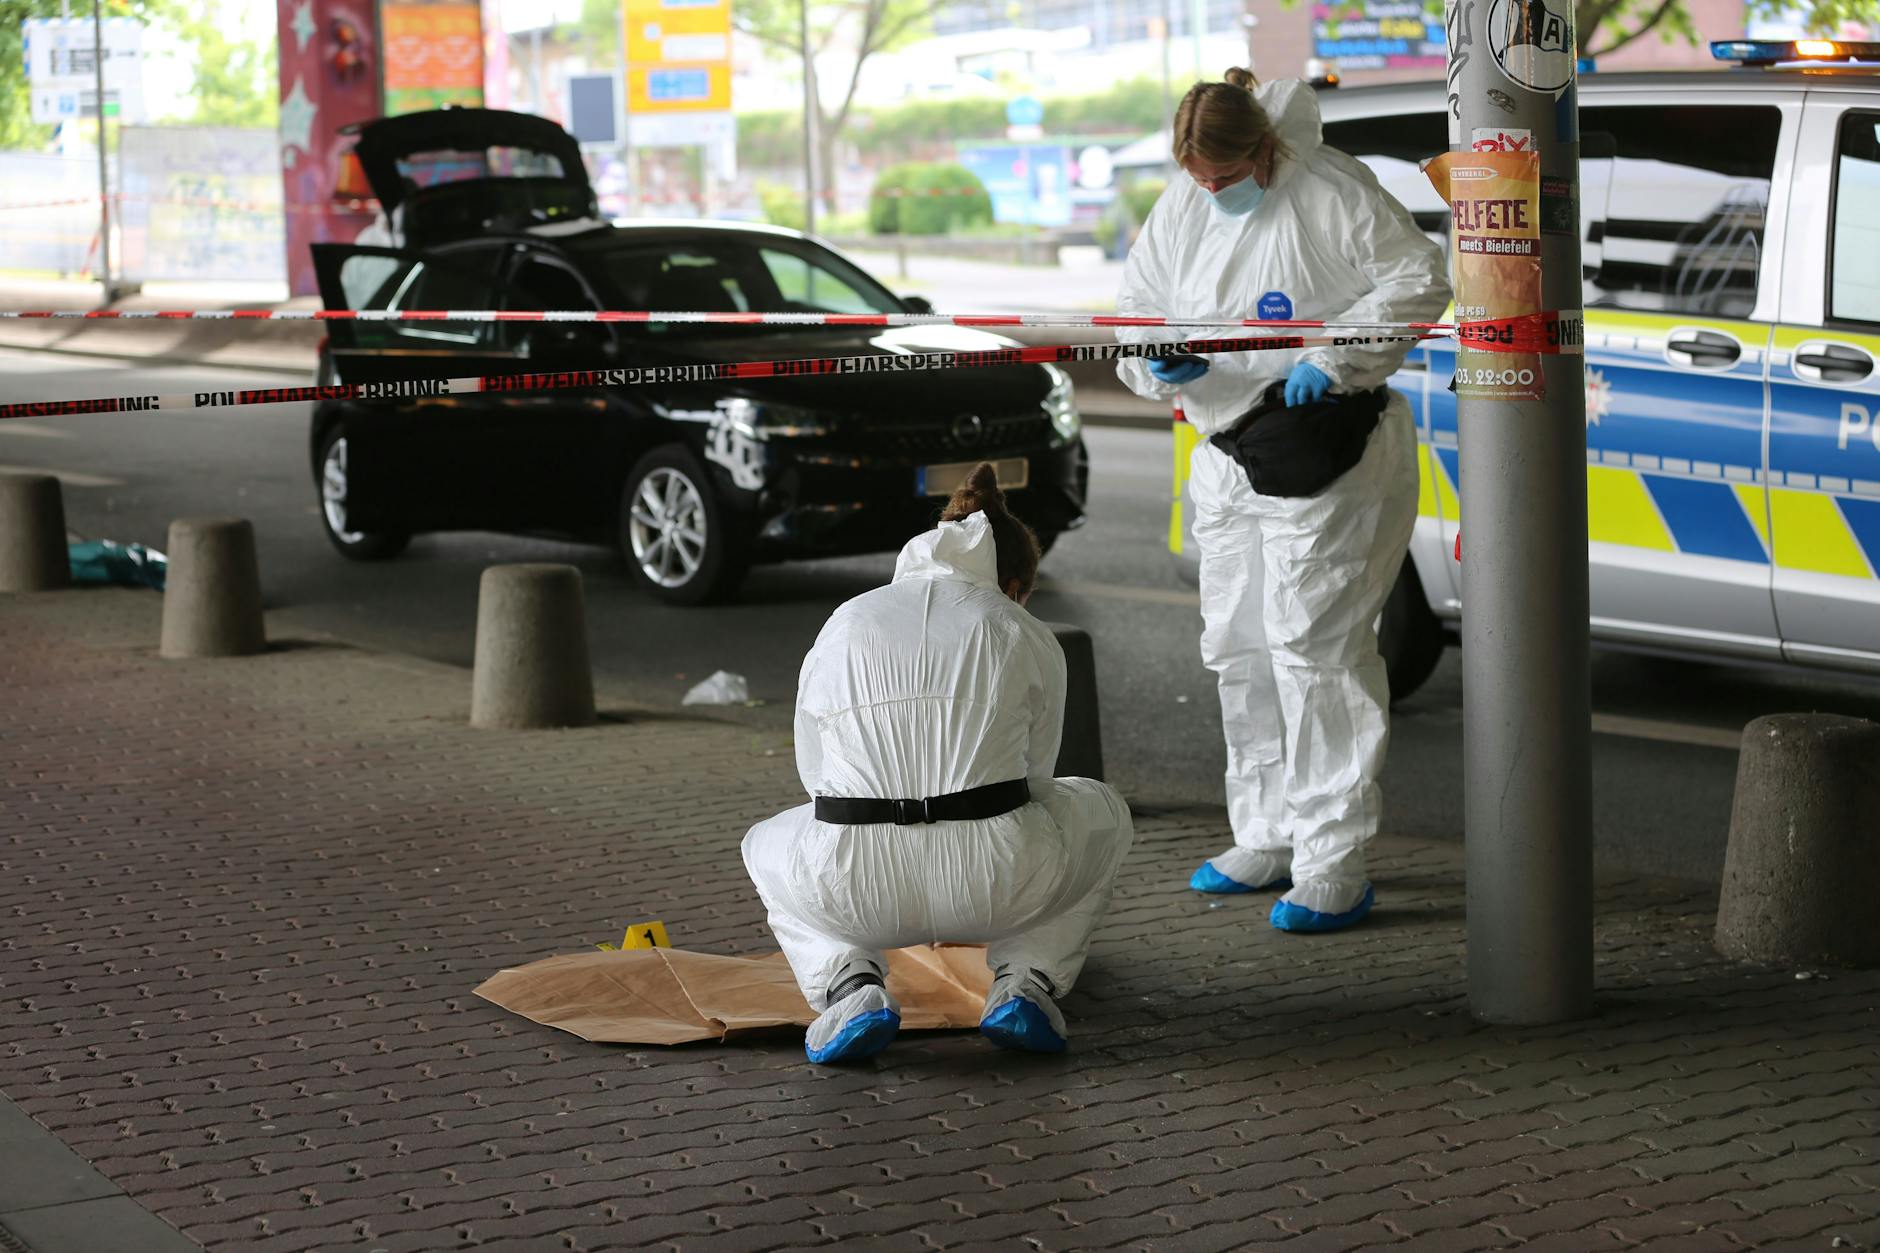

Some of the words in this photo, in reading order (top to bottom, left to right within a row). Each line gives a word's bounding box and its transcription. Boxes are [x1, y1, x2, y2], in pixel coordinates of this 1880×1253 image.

[1460, 240, 1483, 252] meets
[1486, 240, 1531, 254] Bielefeld
[1263, 304, 1287, 315] Tyvek
[1476, 369, 1534, 385] 22:00
[1838, 402, 1880, 453] P
